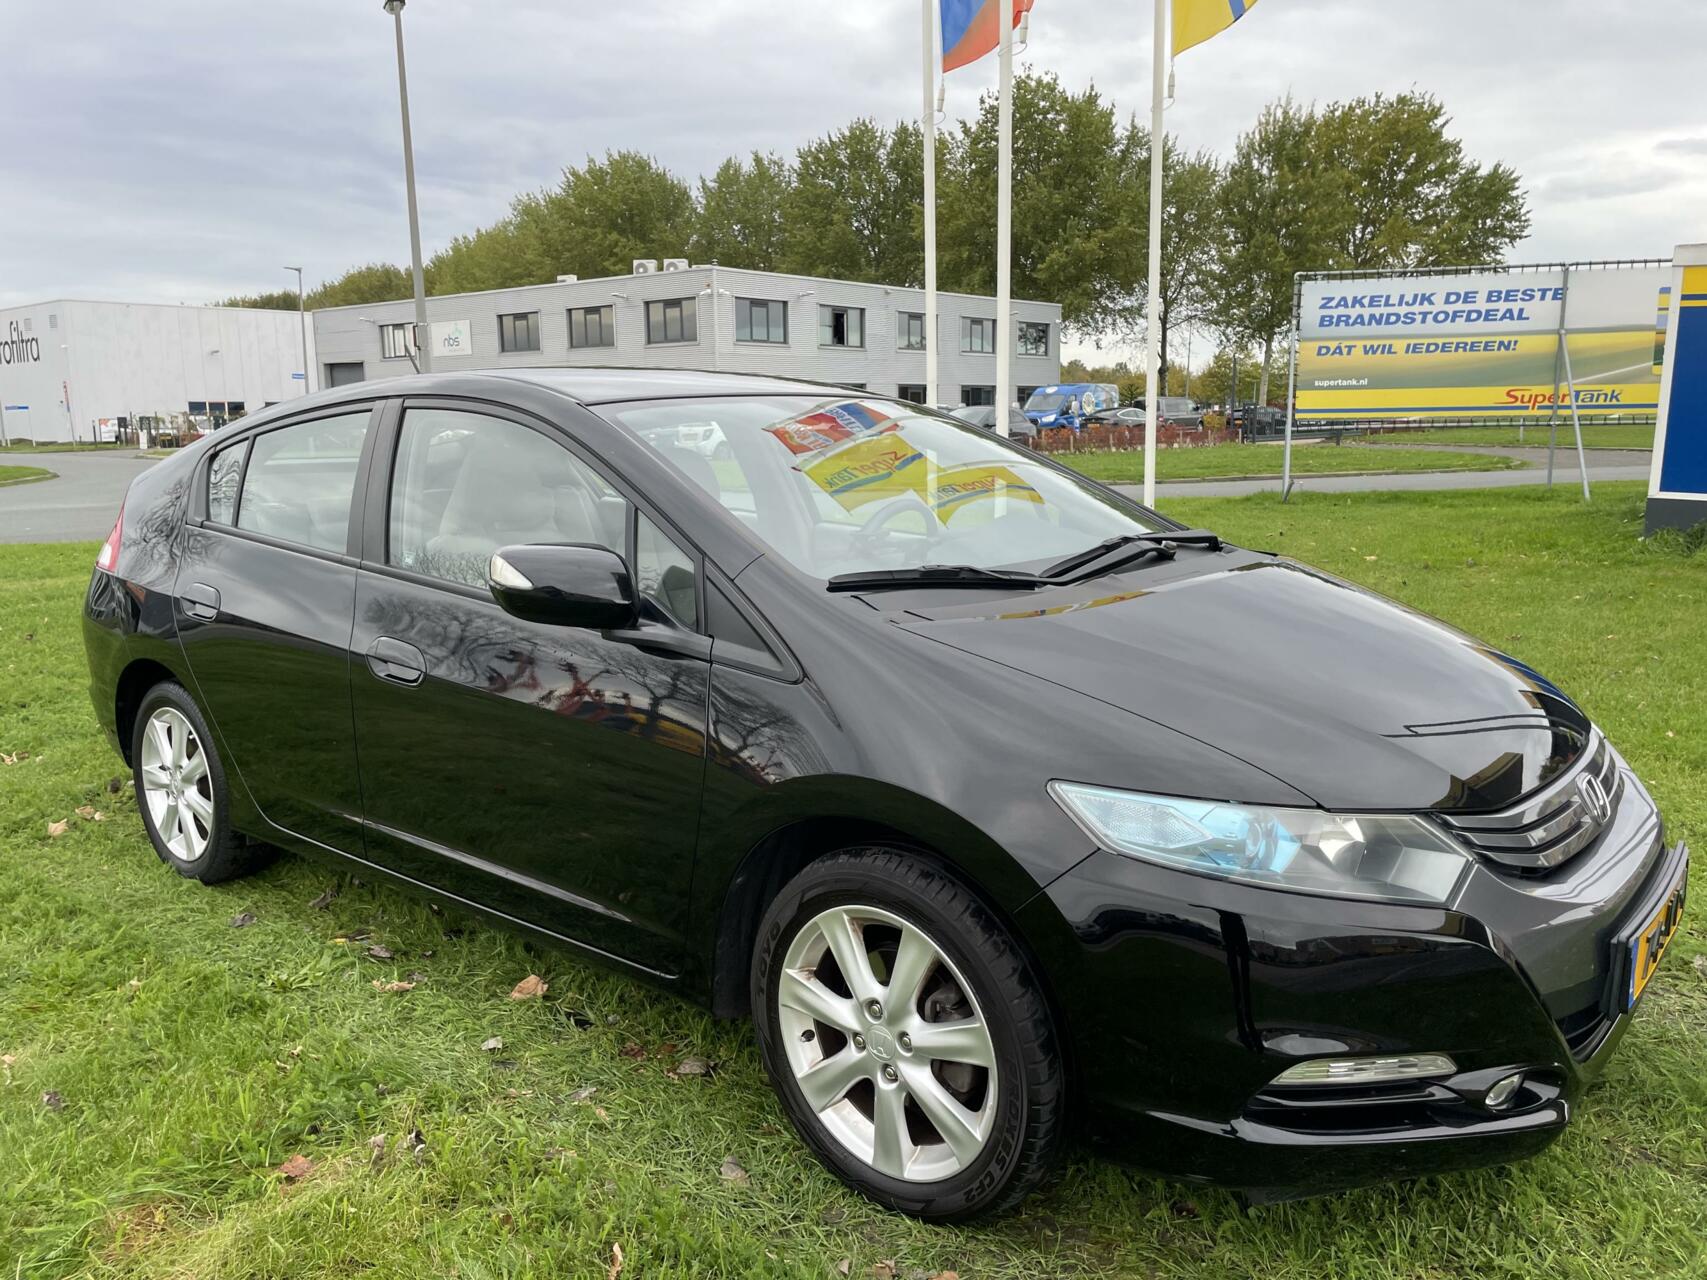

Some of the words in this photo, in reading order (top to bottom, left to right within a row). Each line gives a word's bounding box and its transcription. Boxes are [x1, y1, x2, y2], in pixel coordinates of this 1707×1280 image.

[1318, 292, 1437, 310] ZAKELIJK
[1443, 290, 1479, 305] DE
[1485, 286, 1569, 304] BESTE
[1318, 307, 1530, 328] BRANDSTOFDEAL
[442, 333, 461, 348] nbs
[1316, 342, 1357, 357] DÁT
[1362, 343, 1398, 355] WIL
[1404, 340, 1518, 355] IEDEREEN!
[1313, 377, 1368, 388] supertank.nl
[962, 1174, 996, 1204] CF2
